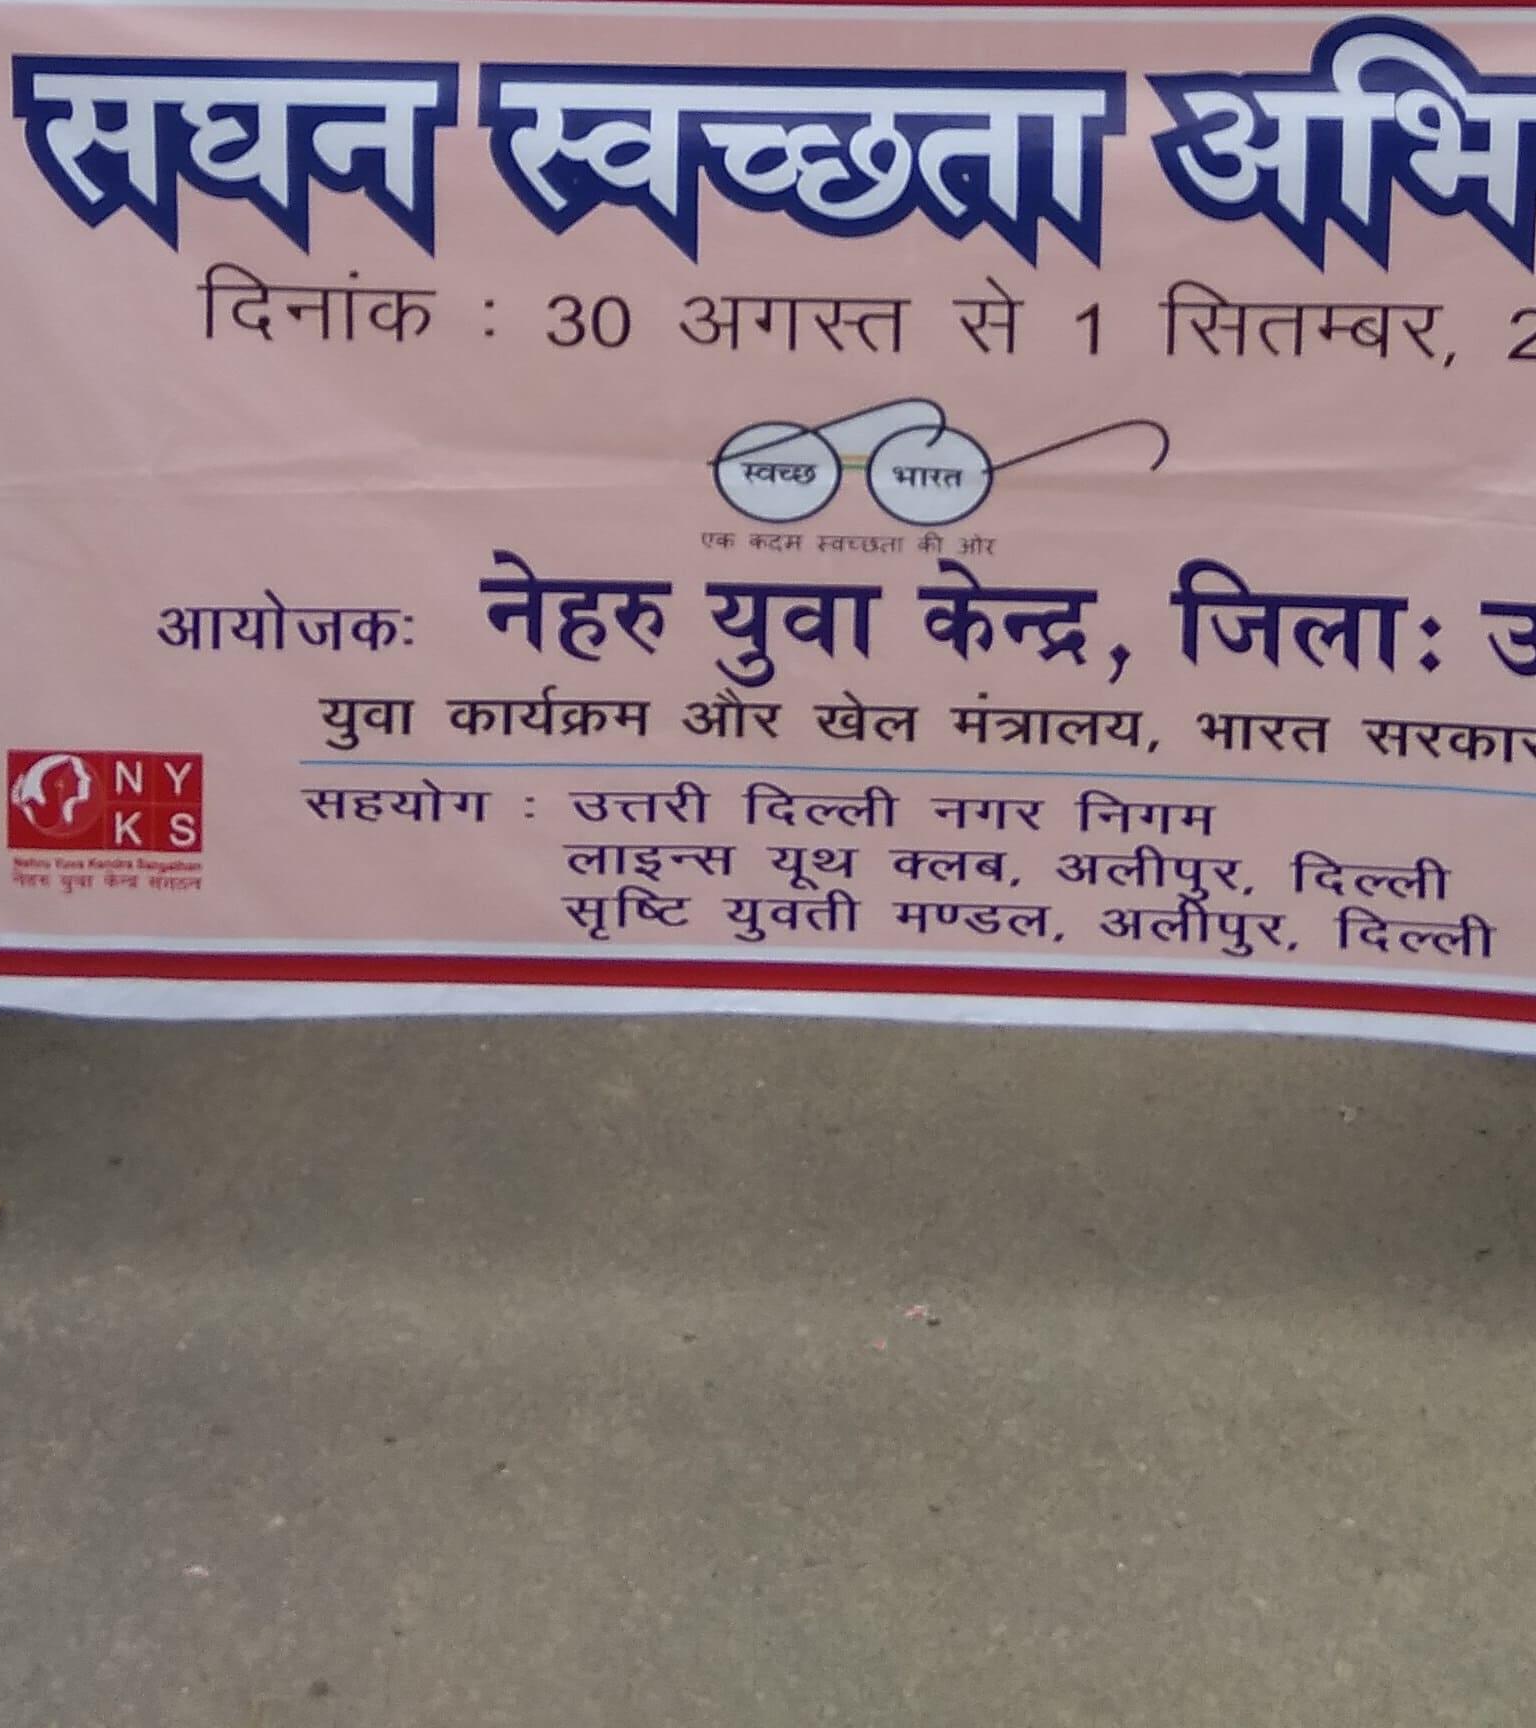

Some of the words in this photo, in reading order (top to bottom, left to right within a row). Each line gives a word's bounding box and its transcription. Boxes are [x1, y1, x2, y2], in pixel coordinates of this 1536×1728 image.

[10, 52, 460, 259] सघन
[479, 62, 1126, 272] स्वच्छता
[198, 261, 437, 345] दिनांक
[545, 294, 632, 350] 30
[679, 294, 912, 354] अगस्त
[954, 276, 1025, 357] से
[1076, 304, 1101, 356] 1
[1159, 278, 1459, 371] सितम्बर,
[740, 461, 817, 486] स्वच्छ
[892, 465, 964, 489] भारत
[701, 532, 736, 552] एक
[748, 532, 802, 552] कदम
[817, 534, 904, 555] स्वच्छता
[918, 532, 943, 555] की
[959, 534, 998, 556] ओर
[705, 581, 883, 689] युवा
[318, 696, 416, 750] युवा
[446, 685, 650, 738] कार्यक्रम
[682, 689, 783, 740] और
[814, 690, 920, 743] खेल
[949, 693, 1162, 756] मंत्रालय,
[1196, 710, 1331, 756] भारत
[301, 777, 492, 824] सहयोग
[568, 781, 712, 826] उत्तरी
[741, 781, 901, 828] दिल्ली
[931, 797, 1045, 832] नगर
[1075, 790, 1217, 837] निगम
[563, 844, 737, 881] लाइन्स
[767, 846, 860, 890] यूथ
[1290, 850, 1452, 901] दिल्ली
[561, 887, 692, 941] सृष्टि
[722, 888, 862, 944] युवती
[1334, 906, 1498, 959] दिल्ली
